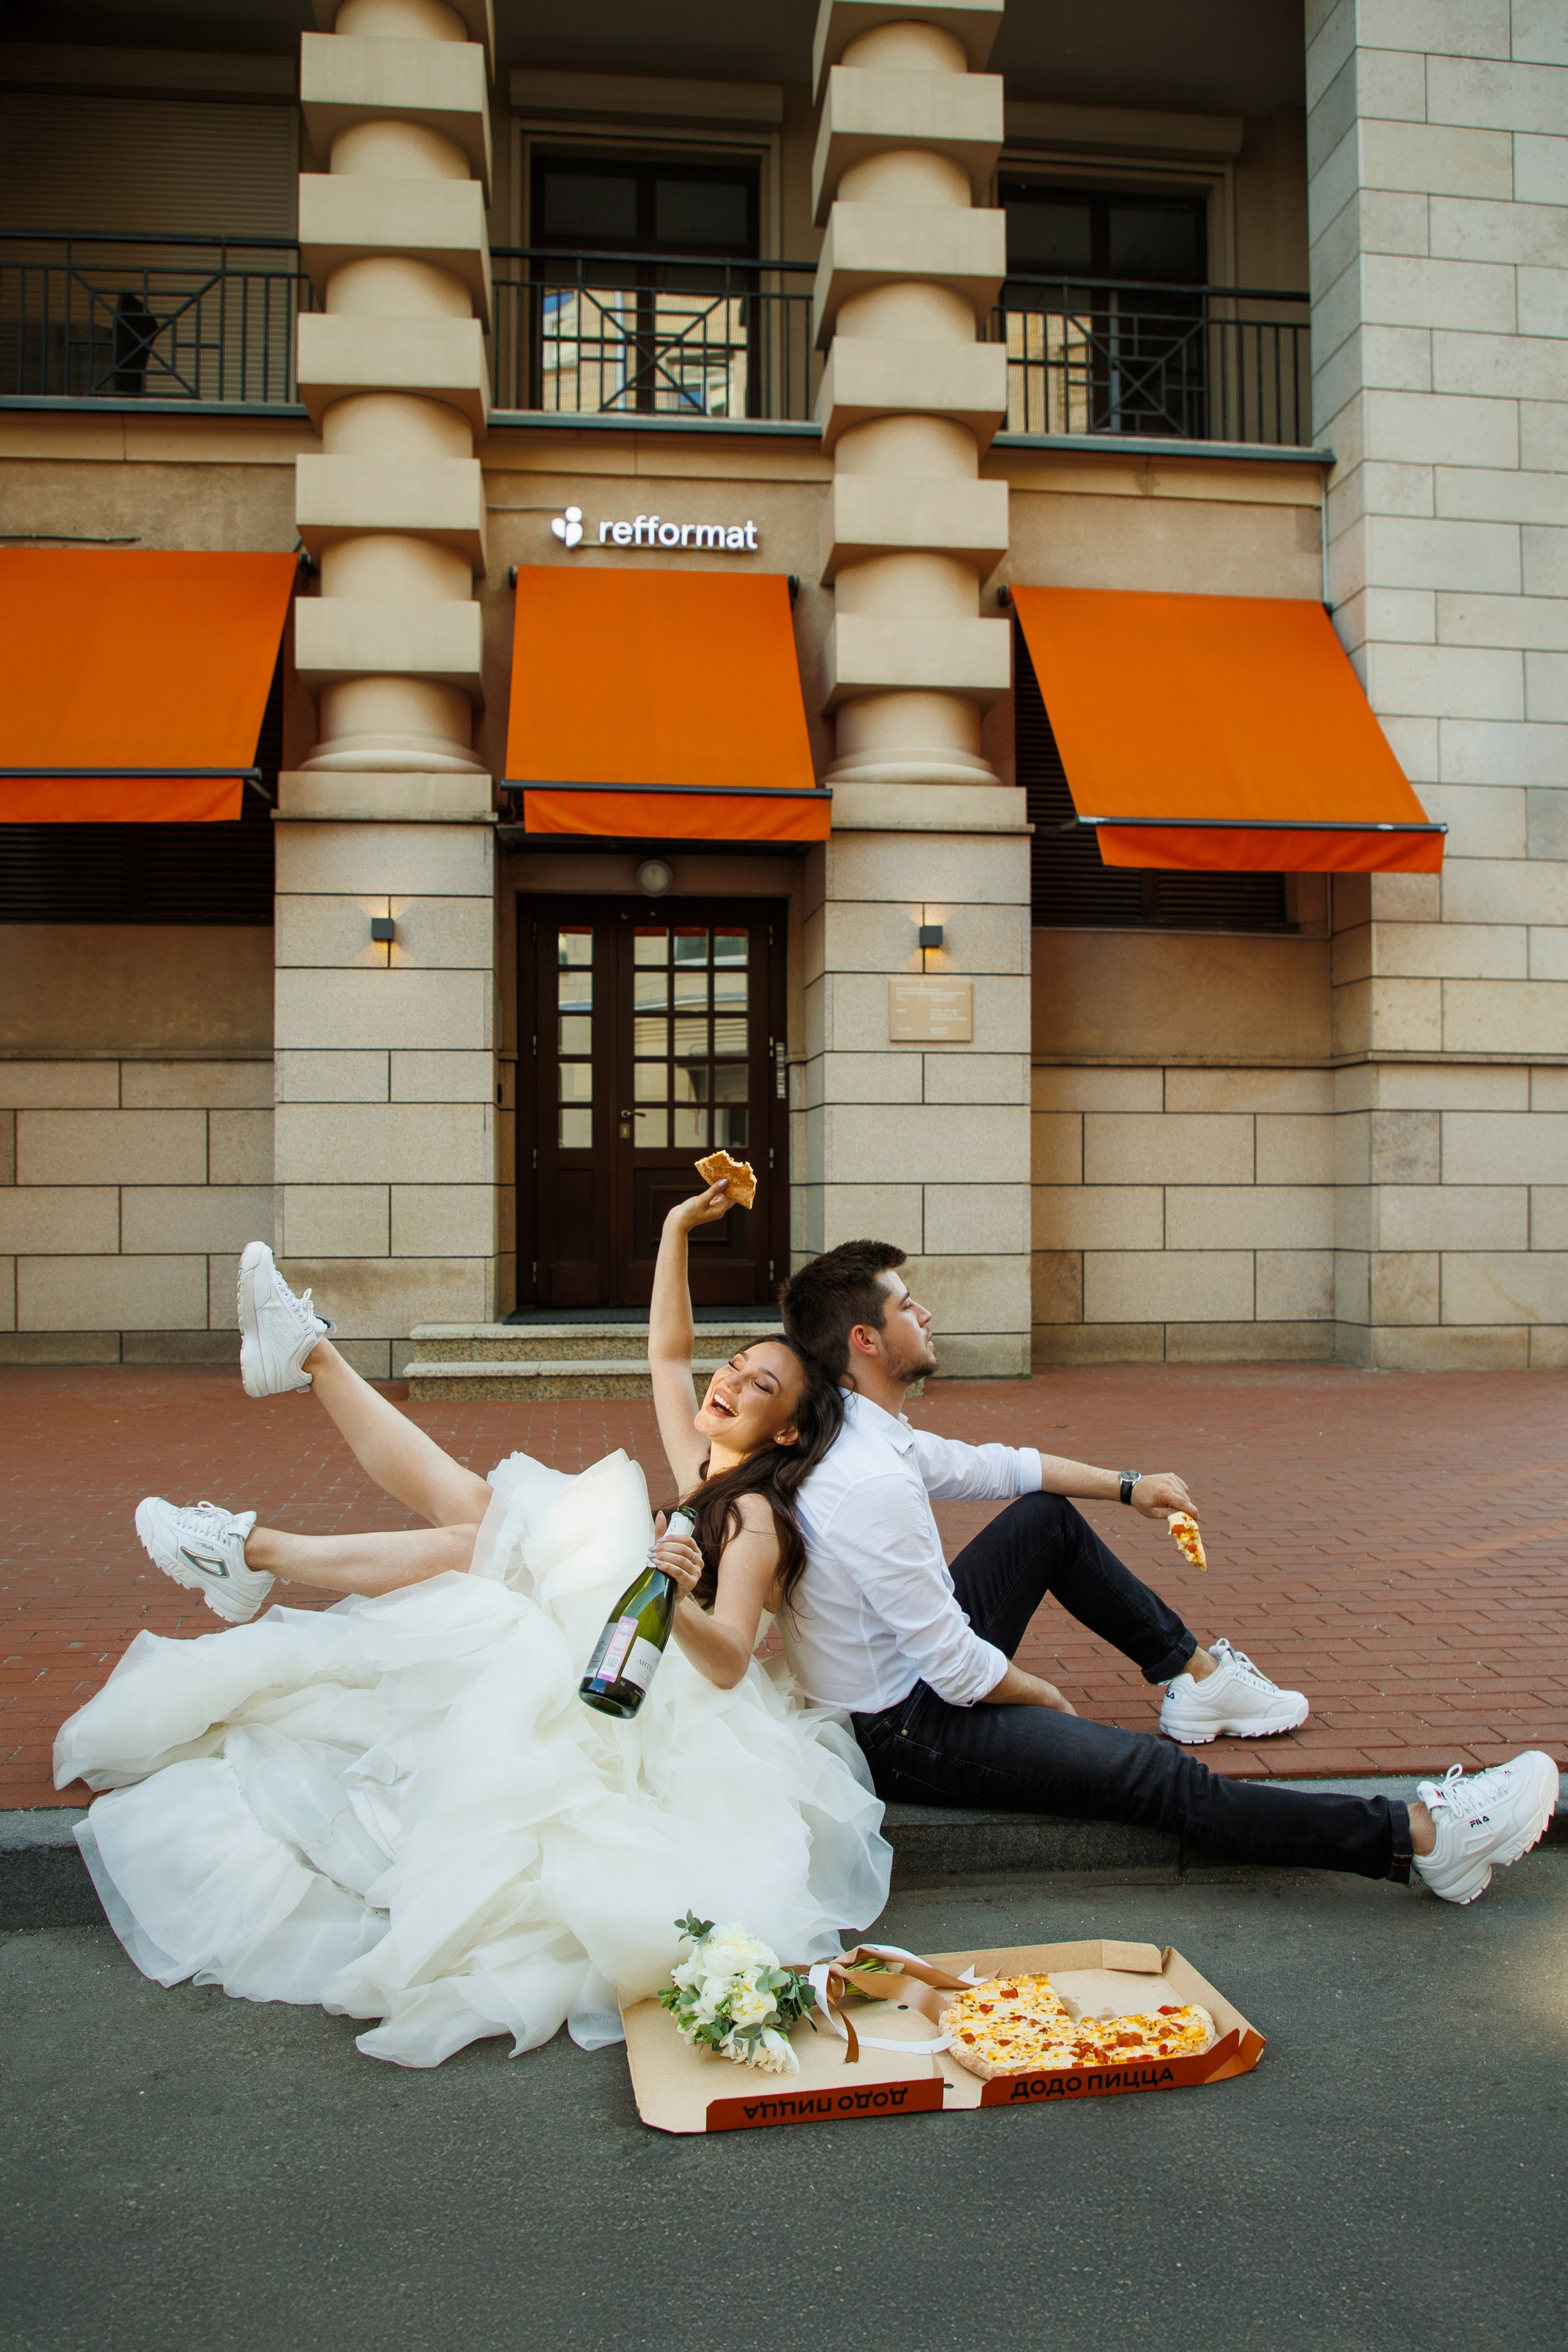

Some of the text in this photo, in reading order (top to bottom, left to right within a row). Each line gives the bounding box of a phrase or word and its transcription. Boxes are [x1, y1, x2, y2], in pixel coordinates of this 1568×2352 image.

[599, 514, 758, 549] refformat
[196, 1541, 214, 1551] FILA
[159, 1555, 186, 1580] FILA
[637, 1658, 653, 1673] ARTE
[1469, 1815, 1490, 1828] FILA
[1011, 2067, 1174, 2100] ДОДО ПИЦЦА
[743, 2087, 908, 2120] ДОДО ПИЦЦА
